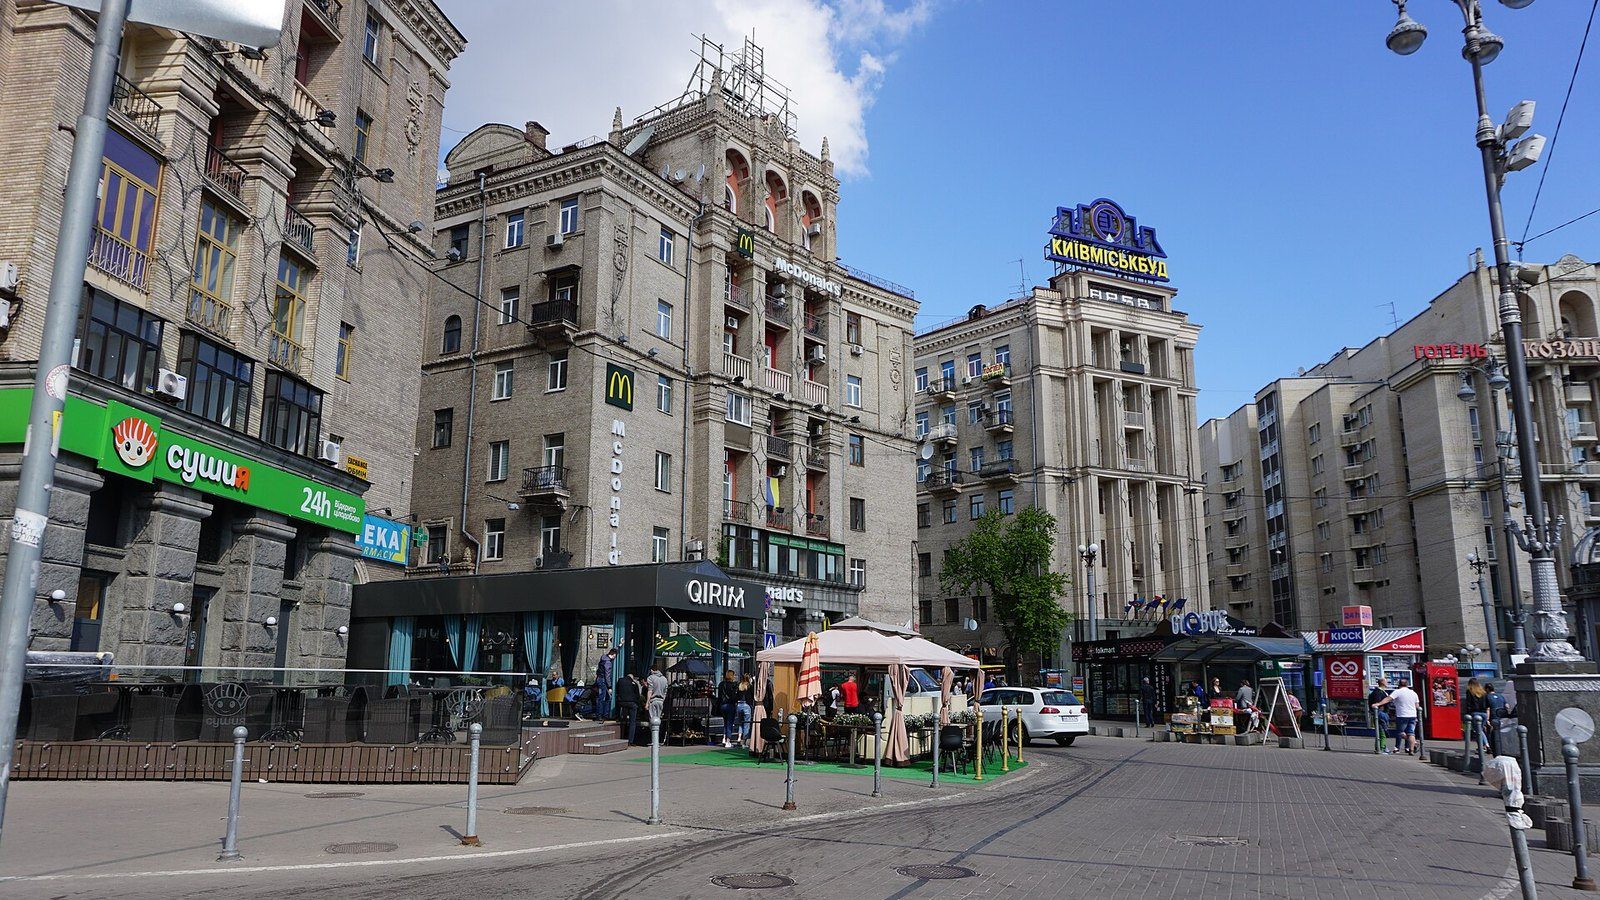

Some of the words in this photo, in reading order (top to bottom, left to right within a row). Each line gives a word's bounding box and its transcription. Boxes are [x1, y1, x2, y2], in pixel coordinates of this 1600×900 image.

[1051, 238, 1168, 278] КИЇВМІСЬКБУД
[775, 257, 840, 297] McDonald's
[1414, 343, 1487, 360] ГОТЕЛЬ
[300, 486, 331, 519] 24h
[355, 524, 399, 551] ЕКА
[687, 579, 745, 609] QIRIM
